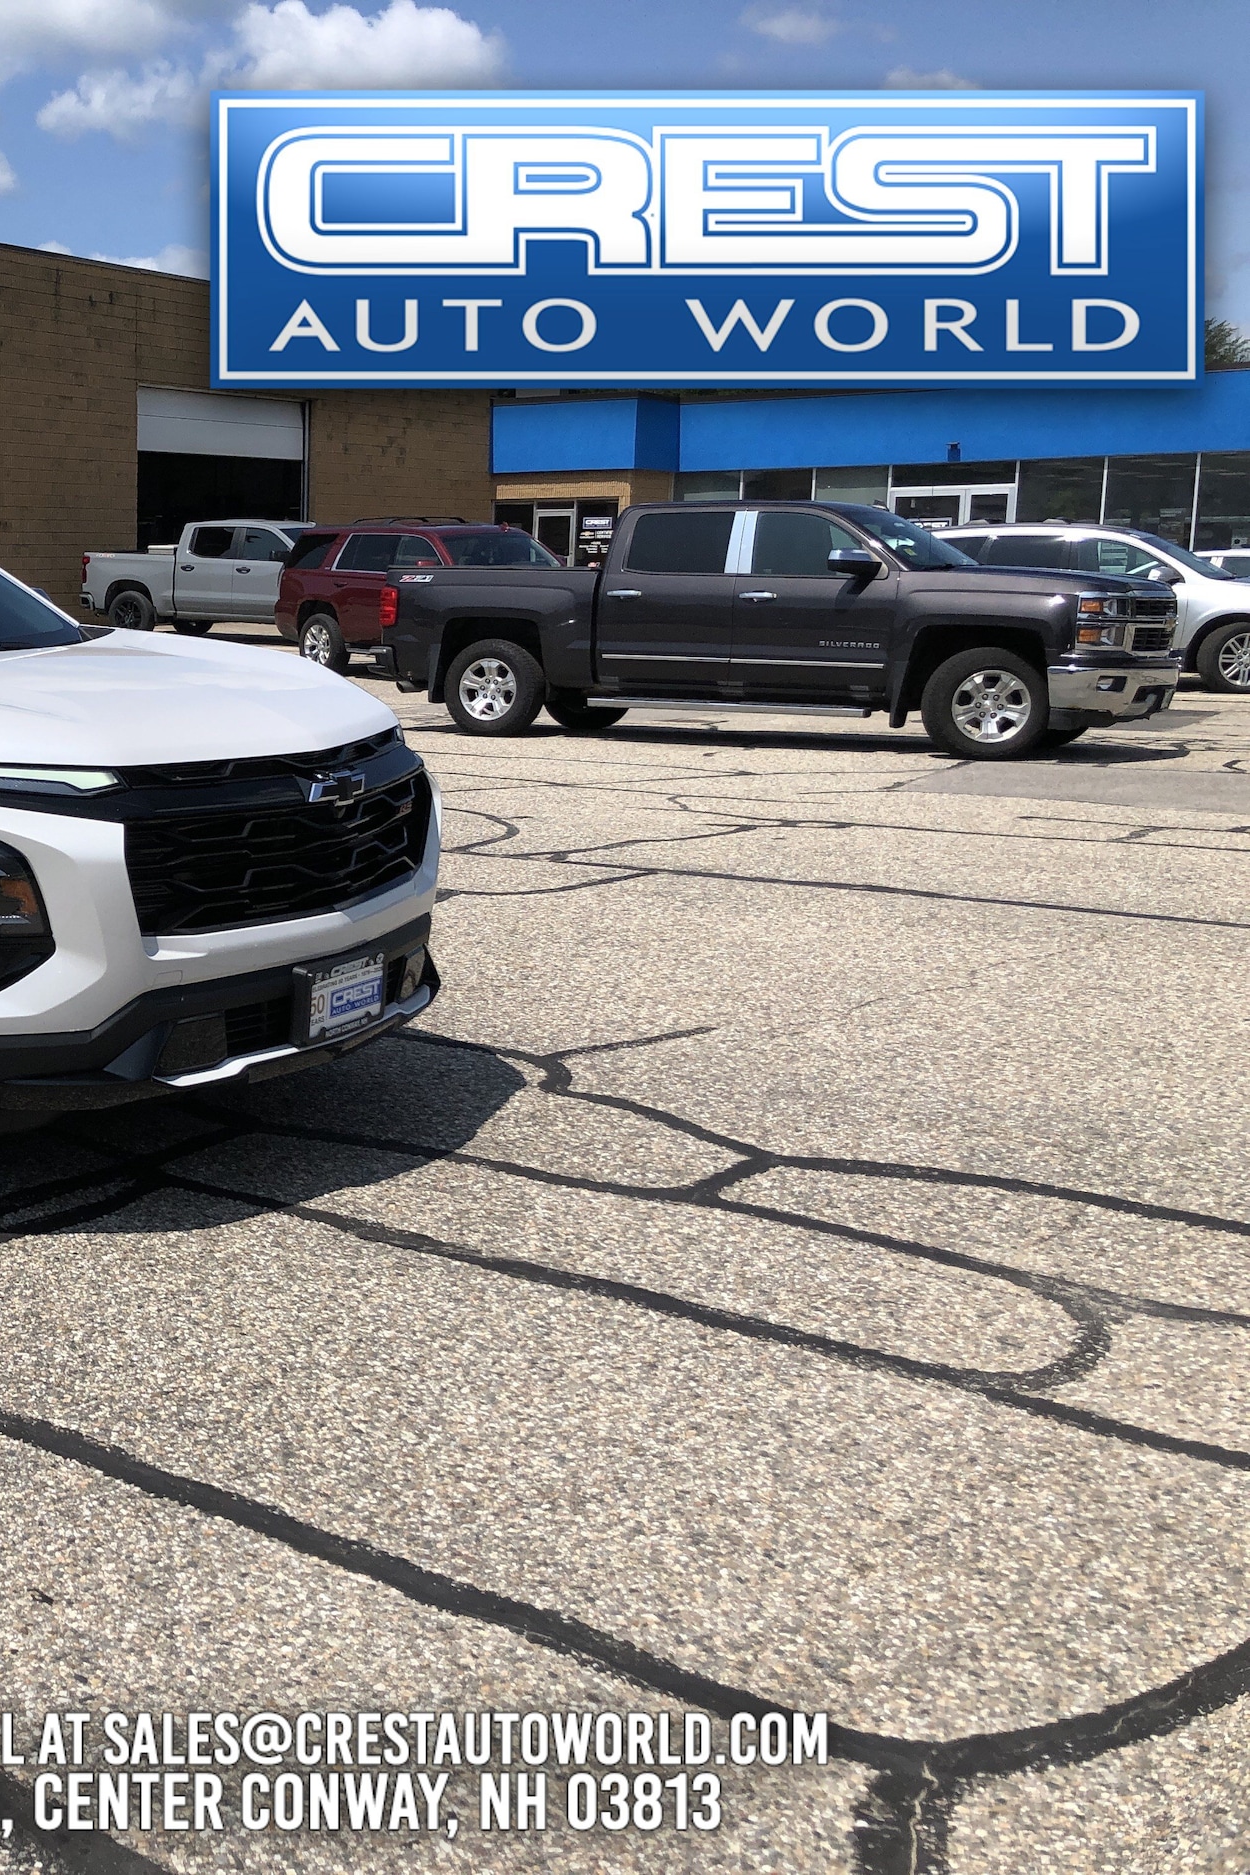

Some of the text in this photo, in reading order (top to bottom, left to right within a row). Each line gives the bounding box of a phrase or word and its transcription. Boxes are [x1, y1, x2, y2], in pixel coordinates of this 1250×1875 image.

[818, 640, 880, 649] SILVERADO
[332, 980, 380, 1008] CREST
[311, 994, 325, 1016] 50
[332, 995, 379, 1015] AUTO WORLD
[310, 1016, 325, 1026] EARS
